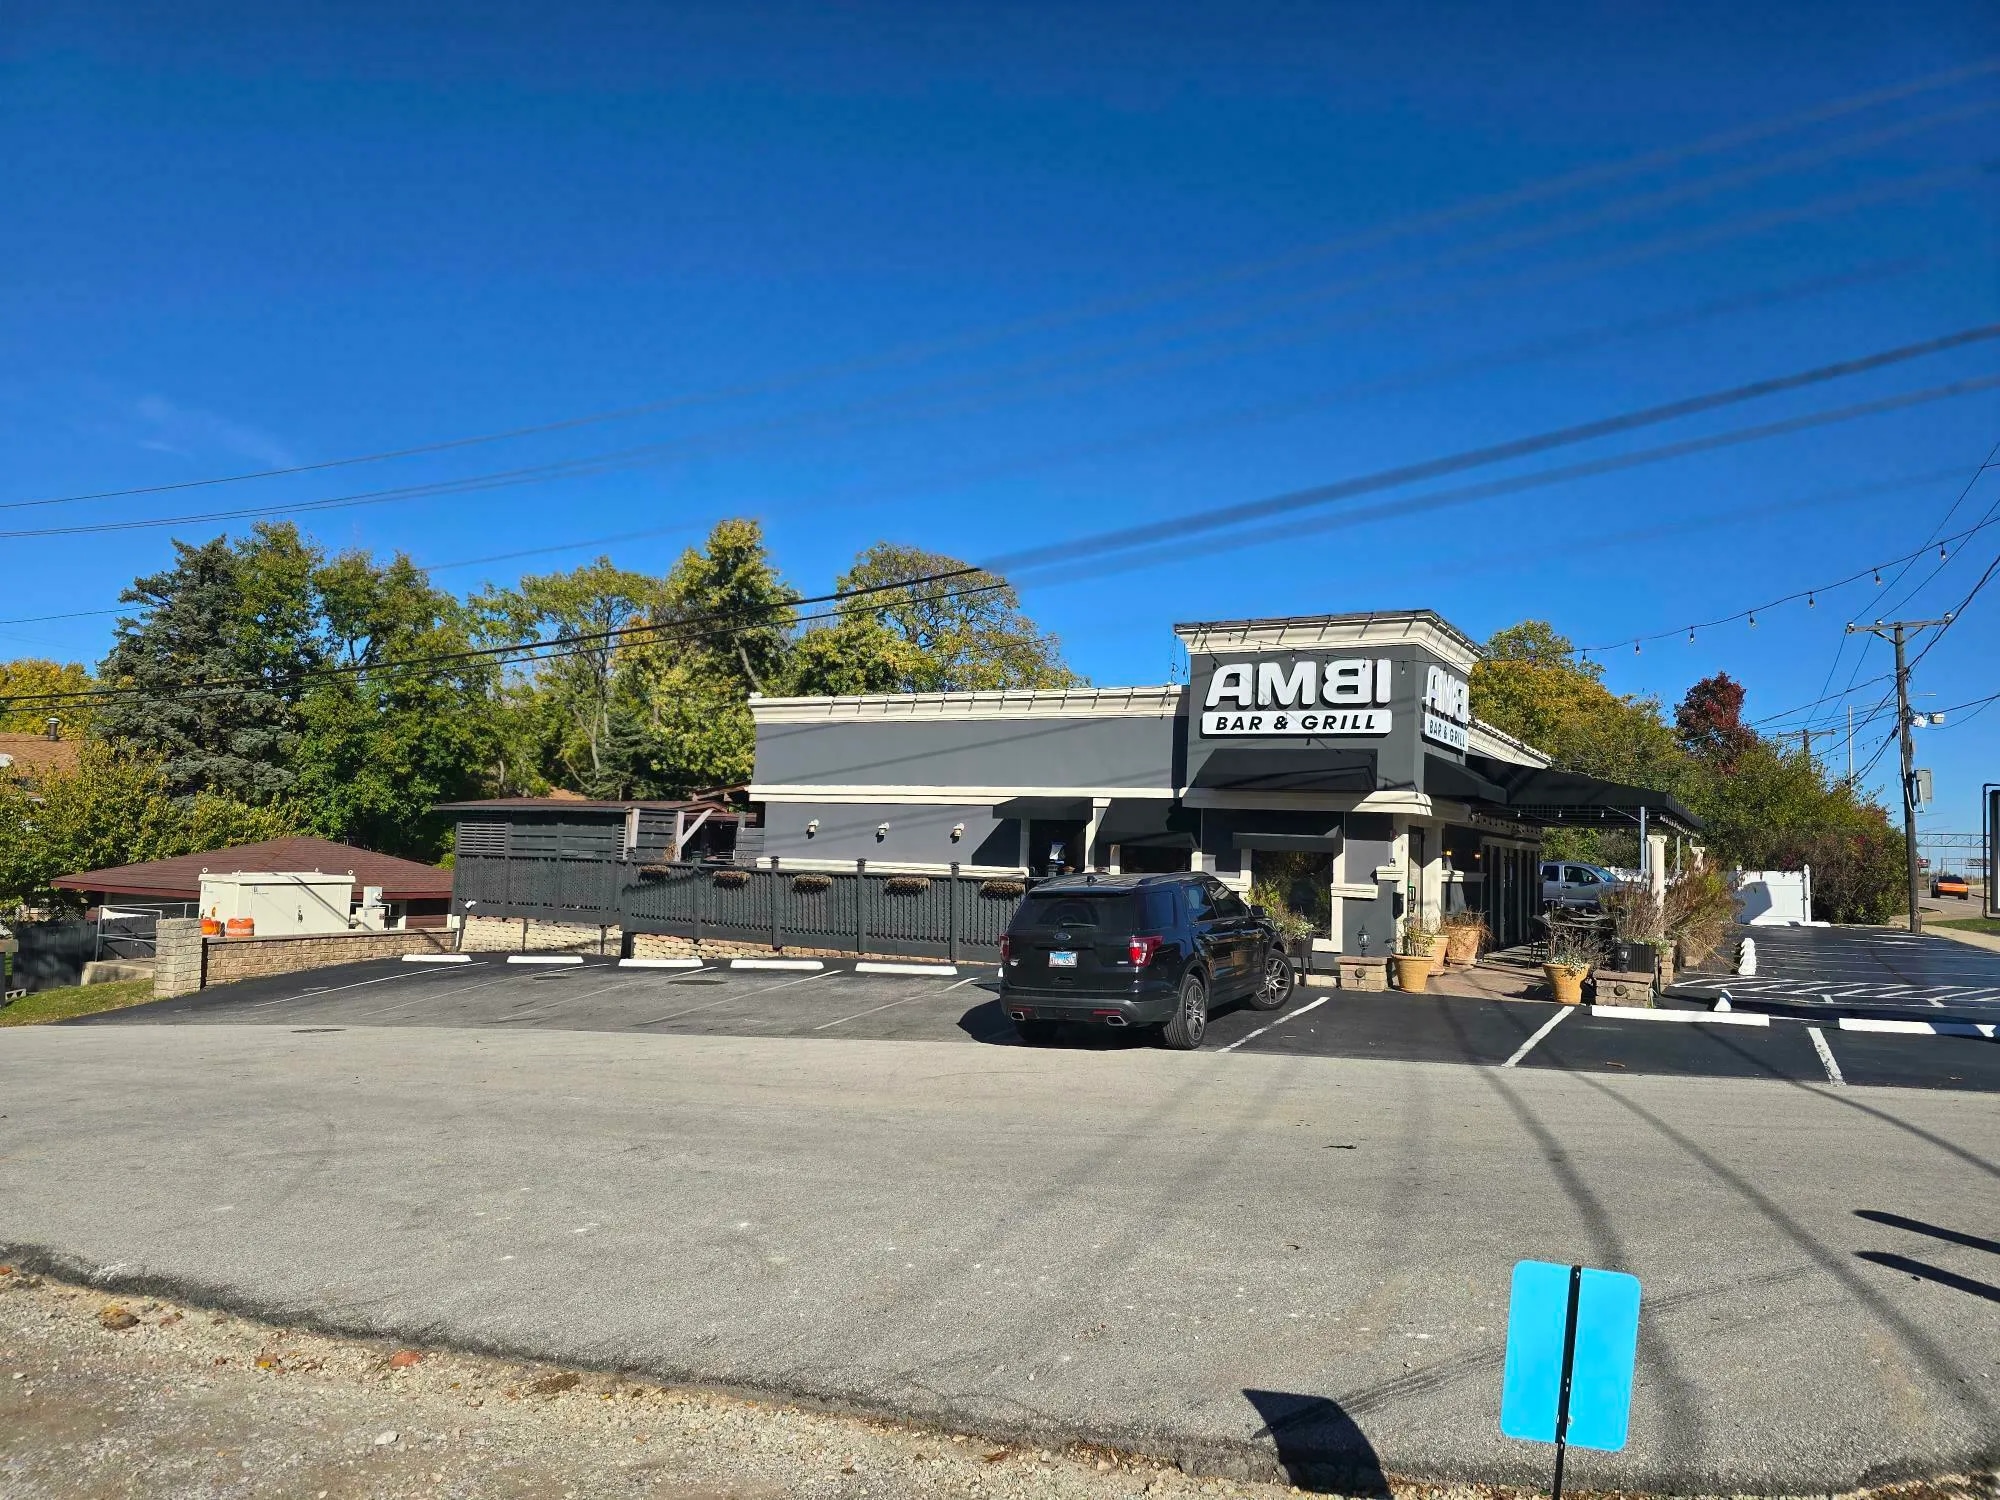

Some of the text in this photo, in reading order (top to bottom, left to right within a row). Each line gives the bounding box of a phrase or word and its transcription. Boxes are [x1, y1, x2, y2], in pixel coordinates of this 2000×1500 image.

[1205, 659, 1392, 707] AMBI
[1215, 713, 1376, 730] BAR & GRILL
[1429, 719, 1442, 738] BAR
[1449, 728, 1465, 748] GRILL
